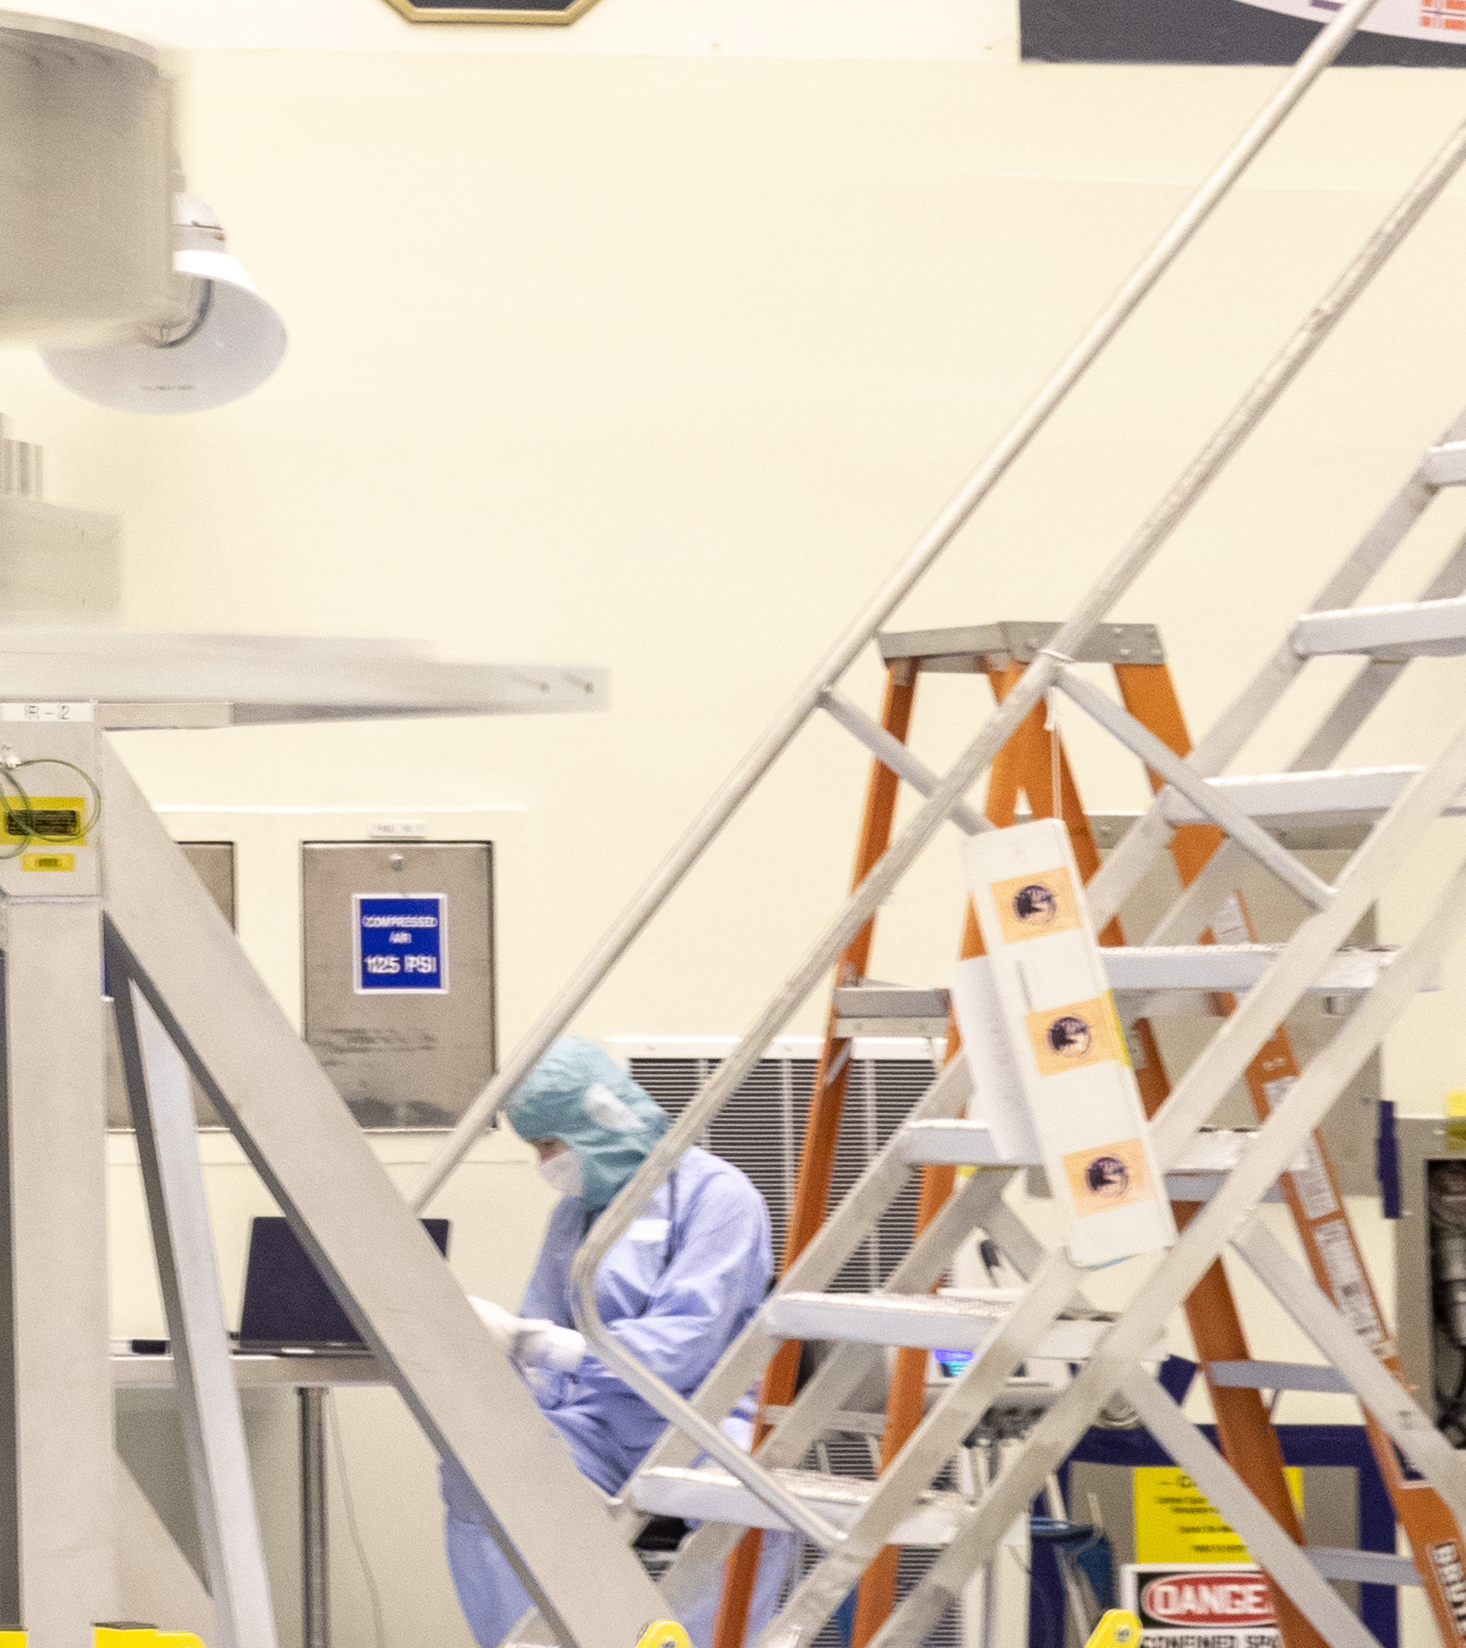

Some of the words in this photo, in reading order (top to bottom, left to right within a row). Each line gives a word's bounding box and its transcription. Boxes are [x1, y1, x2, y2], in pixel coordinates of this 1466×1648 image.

[364, 954, 402, 974] 125
[403, 954, 438, 974] PSI
[1152, 1583, 1273, 1616] DANGE
